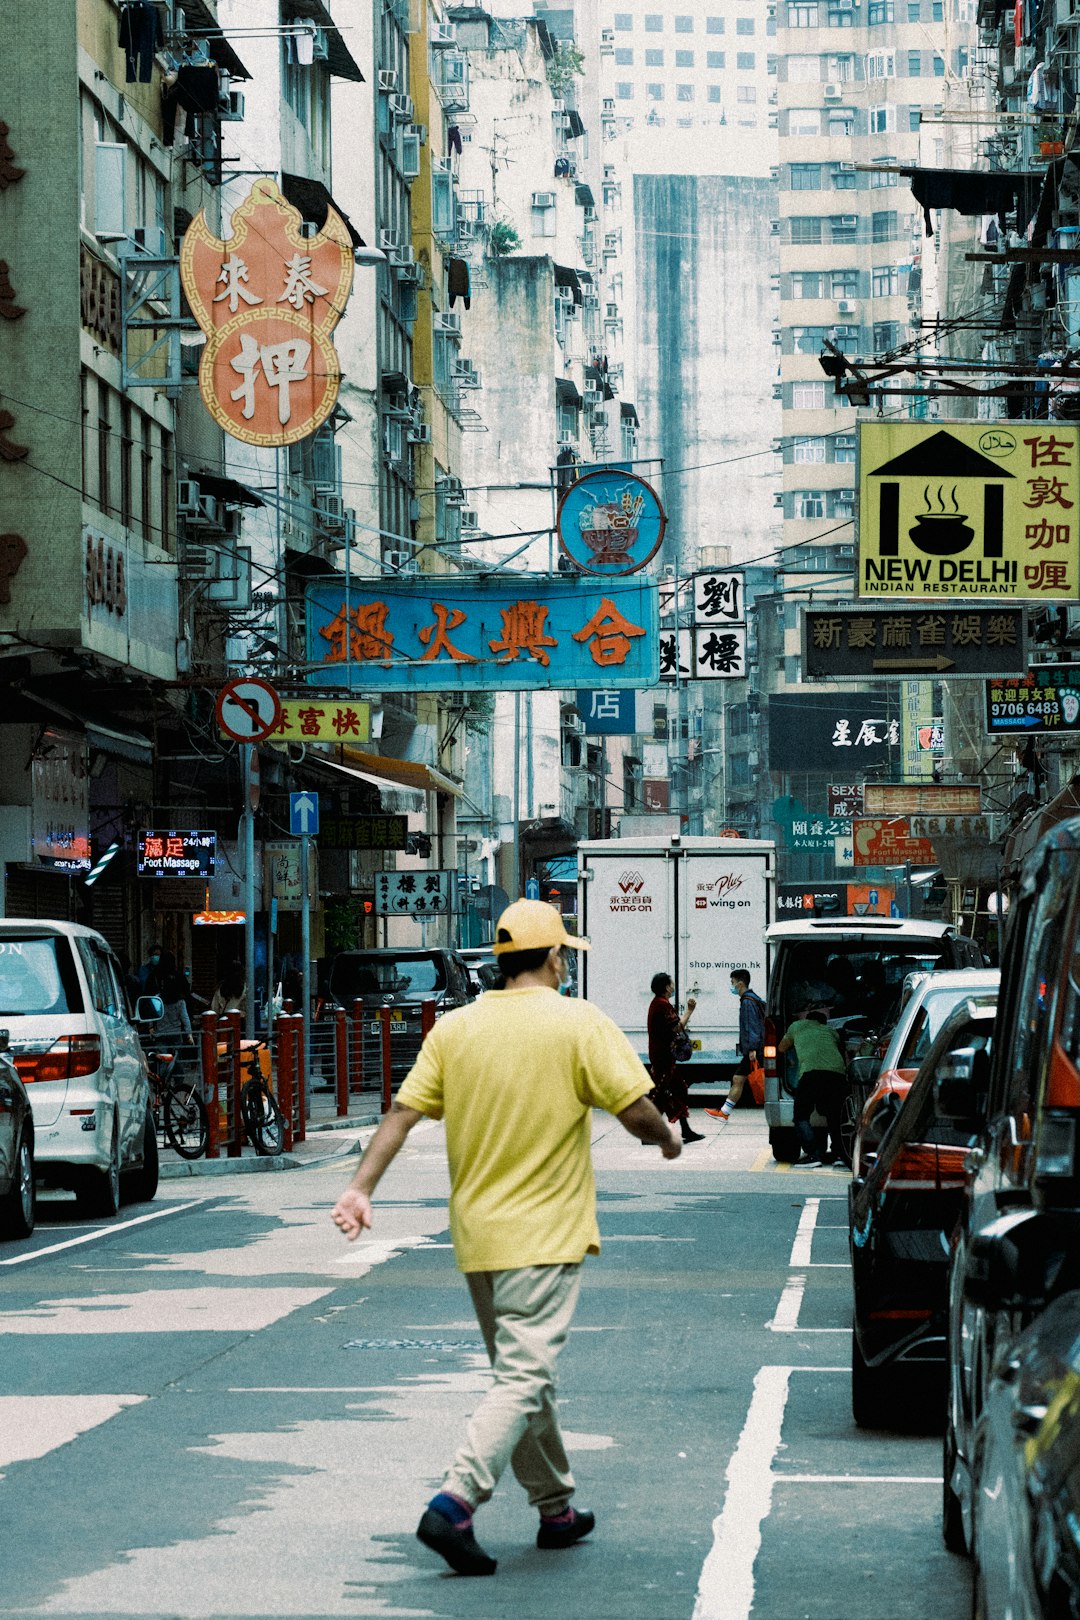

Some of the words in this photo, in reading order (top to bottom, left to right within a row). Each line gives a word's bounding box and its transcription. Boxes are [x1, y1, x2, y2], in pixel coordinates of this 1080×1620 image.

[230, 334, 311, 425] 押
[982, 435, 1015, 451] حلال
[1022, 434, 1075, 591] 佐敦咖喱
[865, 558, 932, 581] NEW
[939, 560, 1018, 583] DELHI
[865, 582, 914, 592] INDIAN
[923, 583, 1017, 593] RESTAURANT
[991, 687, 1056, 702] 歡迎男女賓
[589, 688, 621, 719] 店
[991, 703, 1024, 716] 9706
[1026, 702, 1059, 715] 6483
[1043, 714, 1061, 727] 1/F
[831, 785, 855, 796] SEX
[873, 848, 890, 856] Foot
[892, 848, 927, 857] Massage
[143, 856, 162, 868] Foot
[163, 856, 200, 870] Massage
[714, 872, 747, 897] Plus
[609, 895, 652, 904] 永安百貨
[709, 898, 736, 909] wing
[690, 960, 761, 970] shop.wingon.hk
